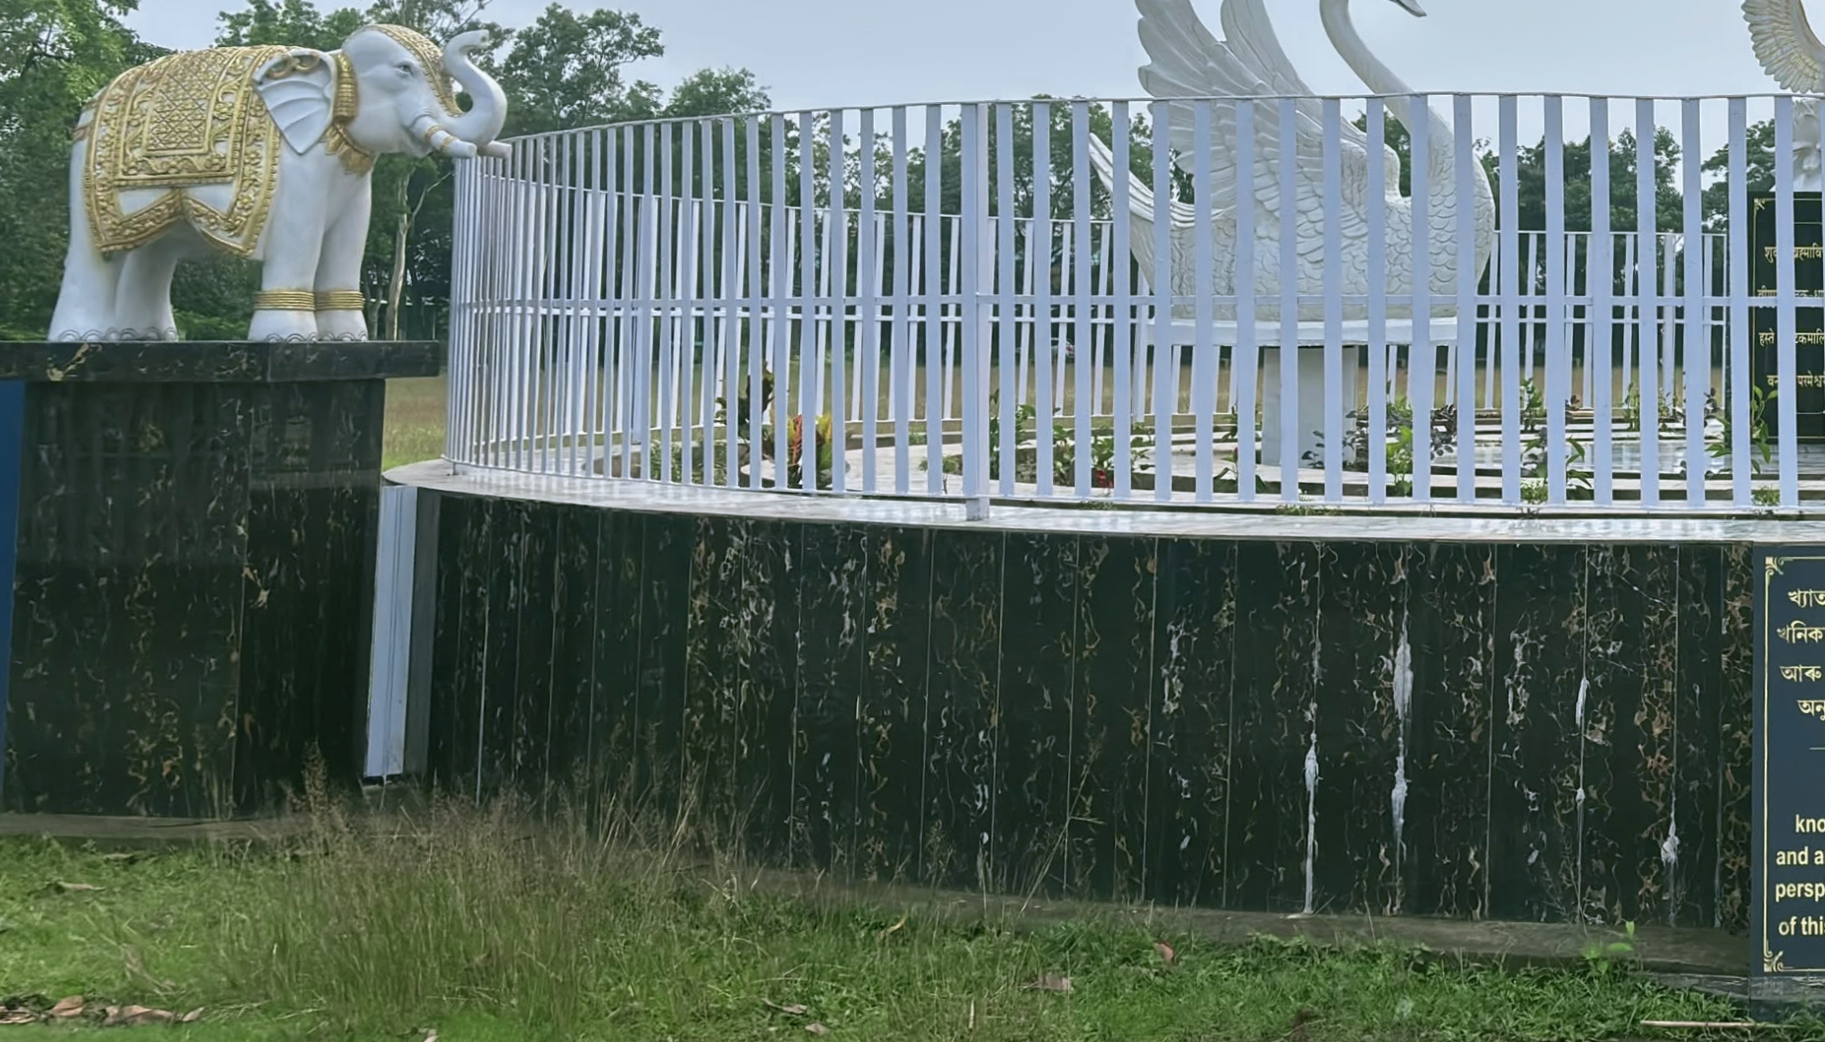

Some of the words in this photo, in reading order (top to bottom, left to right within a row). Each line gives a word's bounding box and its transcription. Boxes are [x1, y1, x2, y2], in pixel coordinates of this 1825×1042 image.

[1758, 327, 1776, 347] हस्ते
[1780, 664, 1822, 682] আৰু
[1775, 845, 1809, 866] and
[1778, 915, 1798, 936] of
